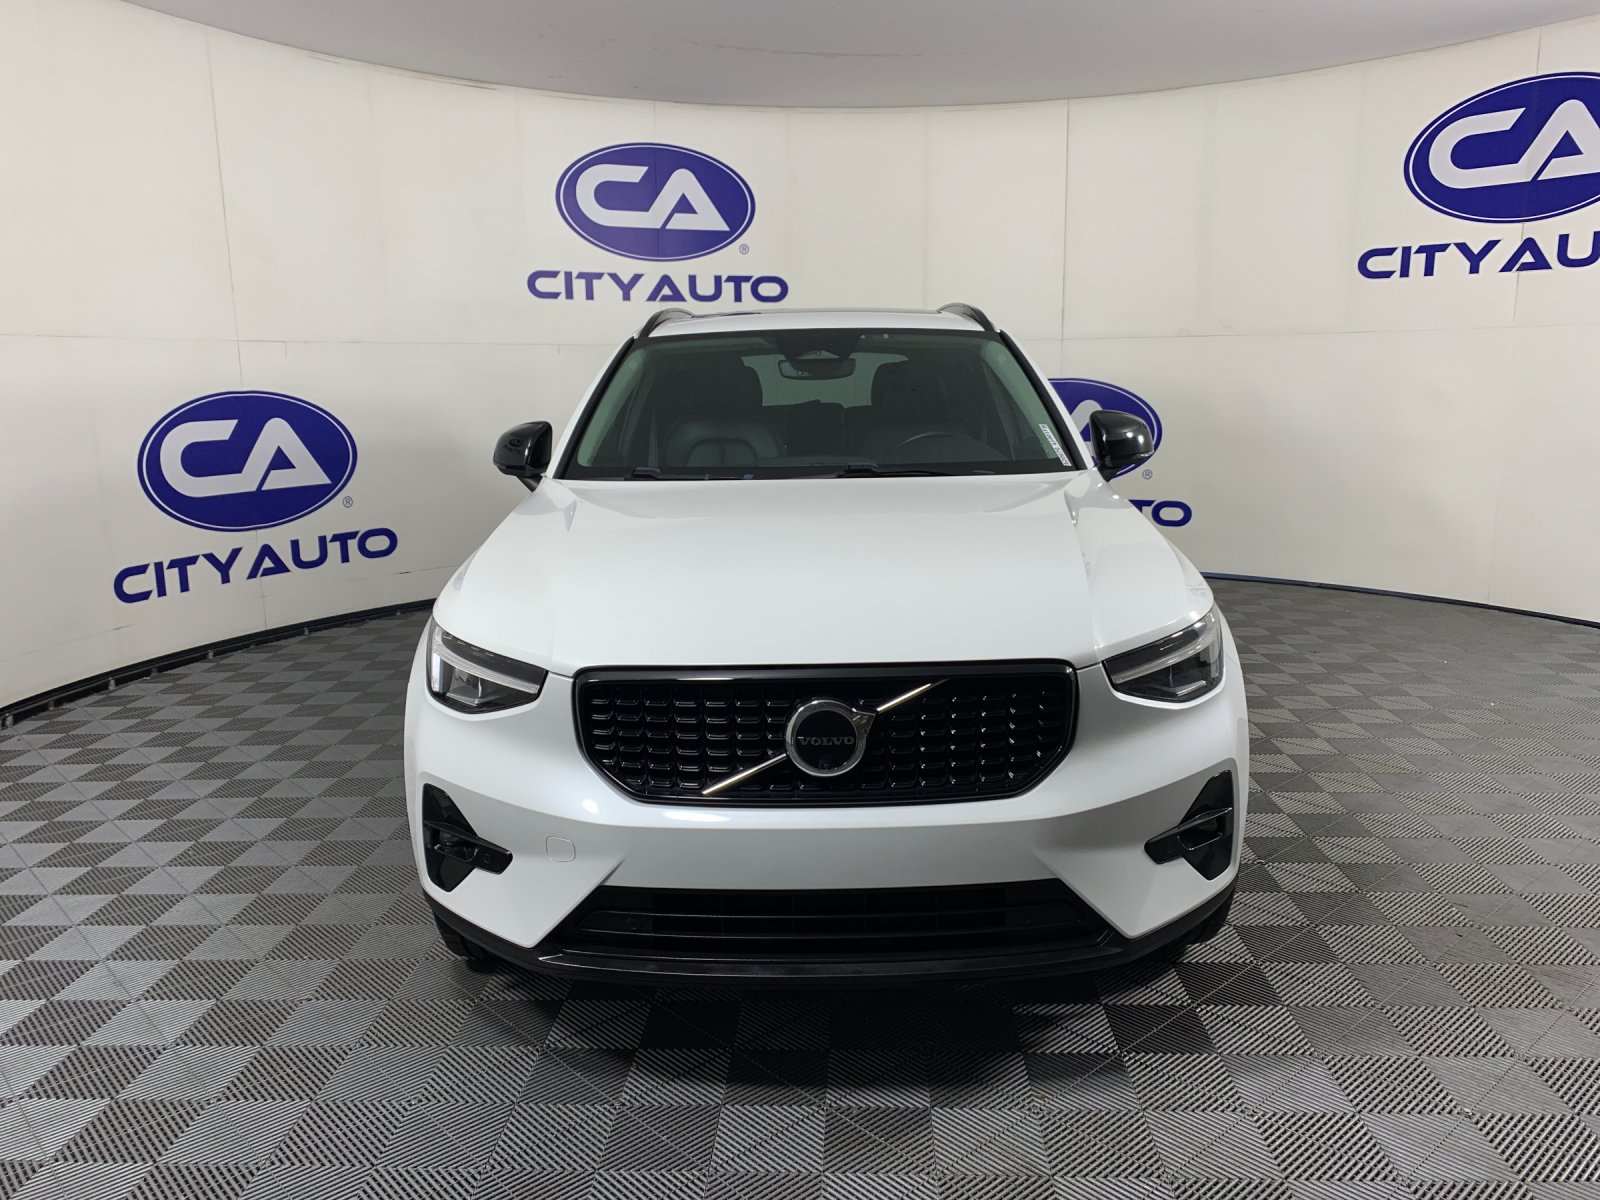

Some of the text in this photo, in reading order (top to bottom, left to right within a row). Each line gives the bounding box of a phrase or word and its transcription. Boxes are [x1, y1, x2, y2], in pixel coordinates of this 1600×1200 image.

[1428, 98, 1600, 189] CA
[575, 163, 731, 231] CA
[159, 417, 332, 498] CA
[799, 736, 855, 746] VOLVO
